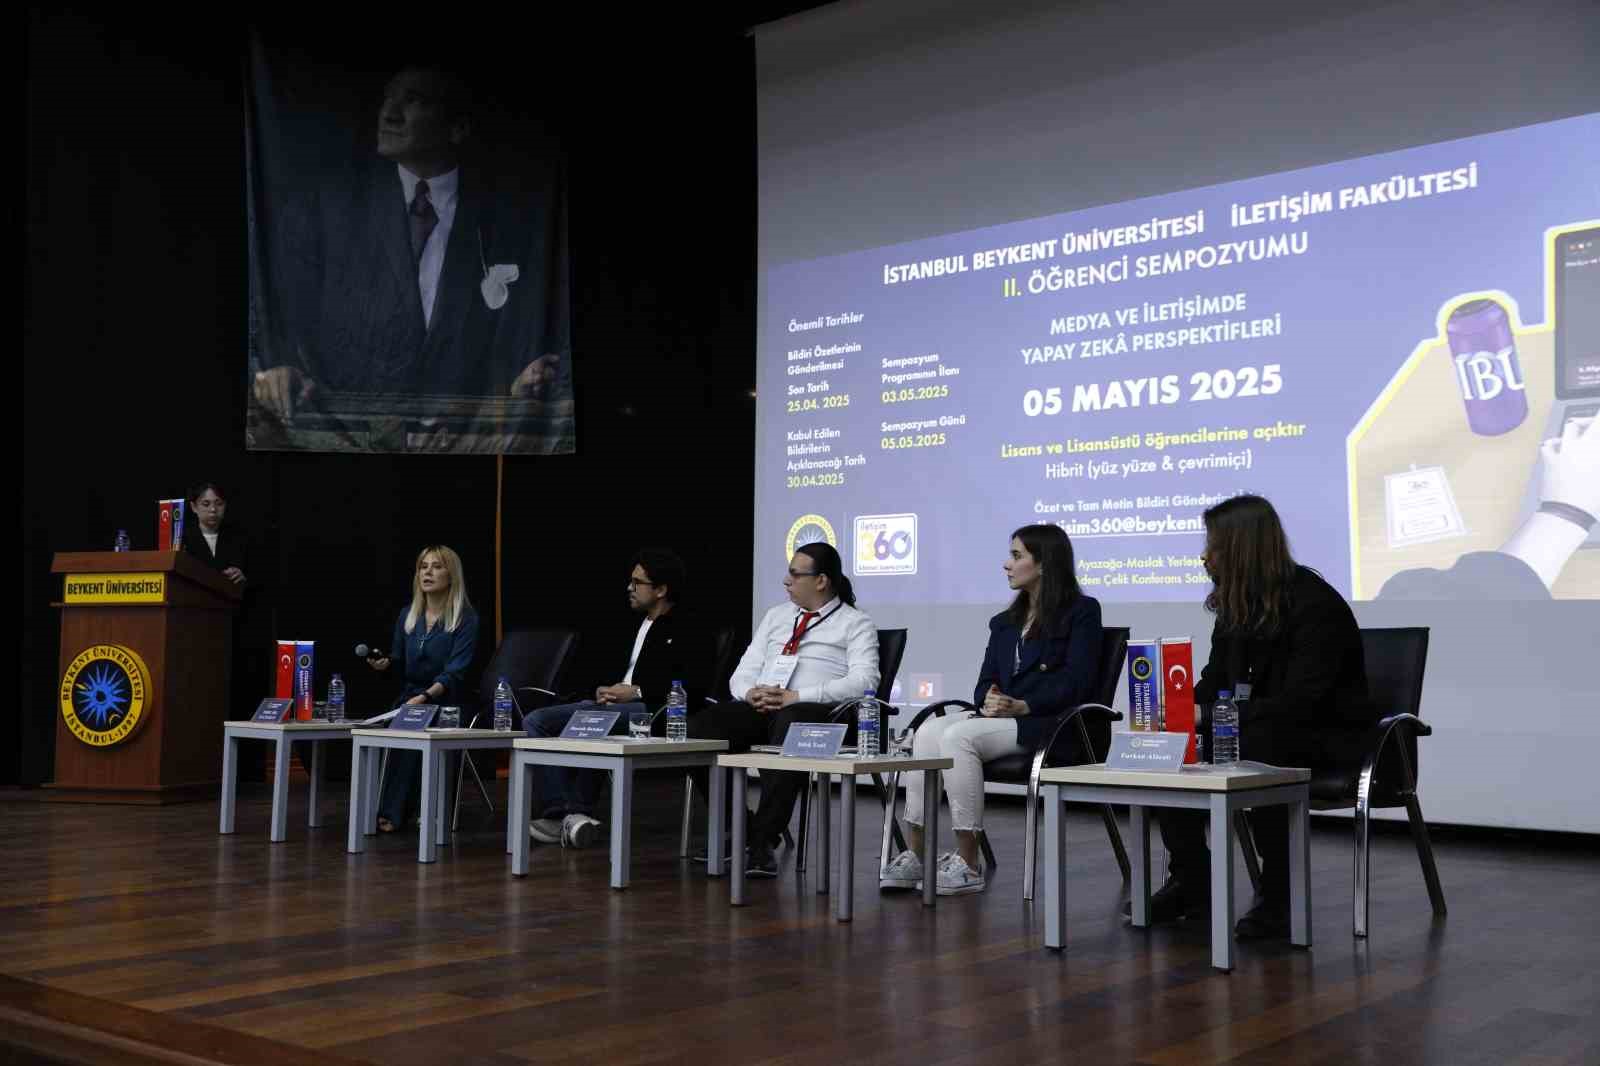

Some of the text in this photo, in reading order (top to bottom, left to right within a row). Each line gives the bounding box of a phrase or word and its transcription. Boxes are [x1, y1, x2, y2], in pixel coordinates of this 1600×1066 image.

[884, 162, 1478, 285] İSTANBUL BEYKENT ÜNİVERSİTESİ İLETİŞİM FAKÜLTESİ
[1028, 255, 1128, 295] ÖĞRENCİ
[1135, 231, 1309, 279] SEMPOZYUMU
[788, 312, 864, 332] Önemli Tarihler
[1050, 293, 1246, 336] MEDYA VE İLETİŞİMDE
[1021, 313, 1281, 366] YAPAY ZEKÂ PERSPEKTİFLERİ
[787, 342, 861, 360] Bildiri Özetlerinin
[787, 359, 844, 375] Gönderilmesi
[882, 354, 939, 368] Sempozyum
[882, 369, 936, 384] Programının
[788, 380, 829, 395] Son Tarih
[882, 385, 948, 402] 03.05.2025
[1023, 364, 1282, 417] 05 MAYIS 2025
[787, 394, 849, 412] 25.04. 2025
[881, 414, 966, 432] Sempozyum Günü
[787, 429, 840, 442] Kabul Edilen
[881, 433, 946, 449] 05.05.2025
[1000, 421, 1306, 458] Lisans ve Lisansüstü öğrencilerine açıktır
[787, 444, 830, 456] Bildirilerin
[787, 454, 866, 472] Açıklanacağı Tarih
[1045, 449, 1252, 480] Hibrit (yüz yüze & çevrimiçi)
[787, 473, 844, 488] 30.04.2025
[1034, 499, 1060, 513] Özet
[1063, 503, 1074, 511] ve
[1077, 500, 1099, 511] Tam
[1103, 499, 1133, 511] Metin
[1137, 496, 1169, 508] Bildiri
[1079, 556, 1163, 571] Ayazağa-Maslak
[67, 579, 162, 595] BEYKENT ÜNİVERSİTESİ
[1104, 573, 1129, 588] Çelik
[1132, 572, 1182, 586] Konferans
[63, 653, 91, 701] BEYKENT
